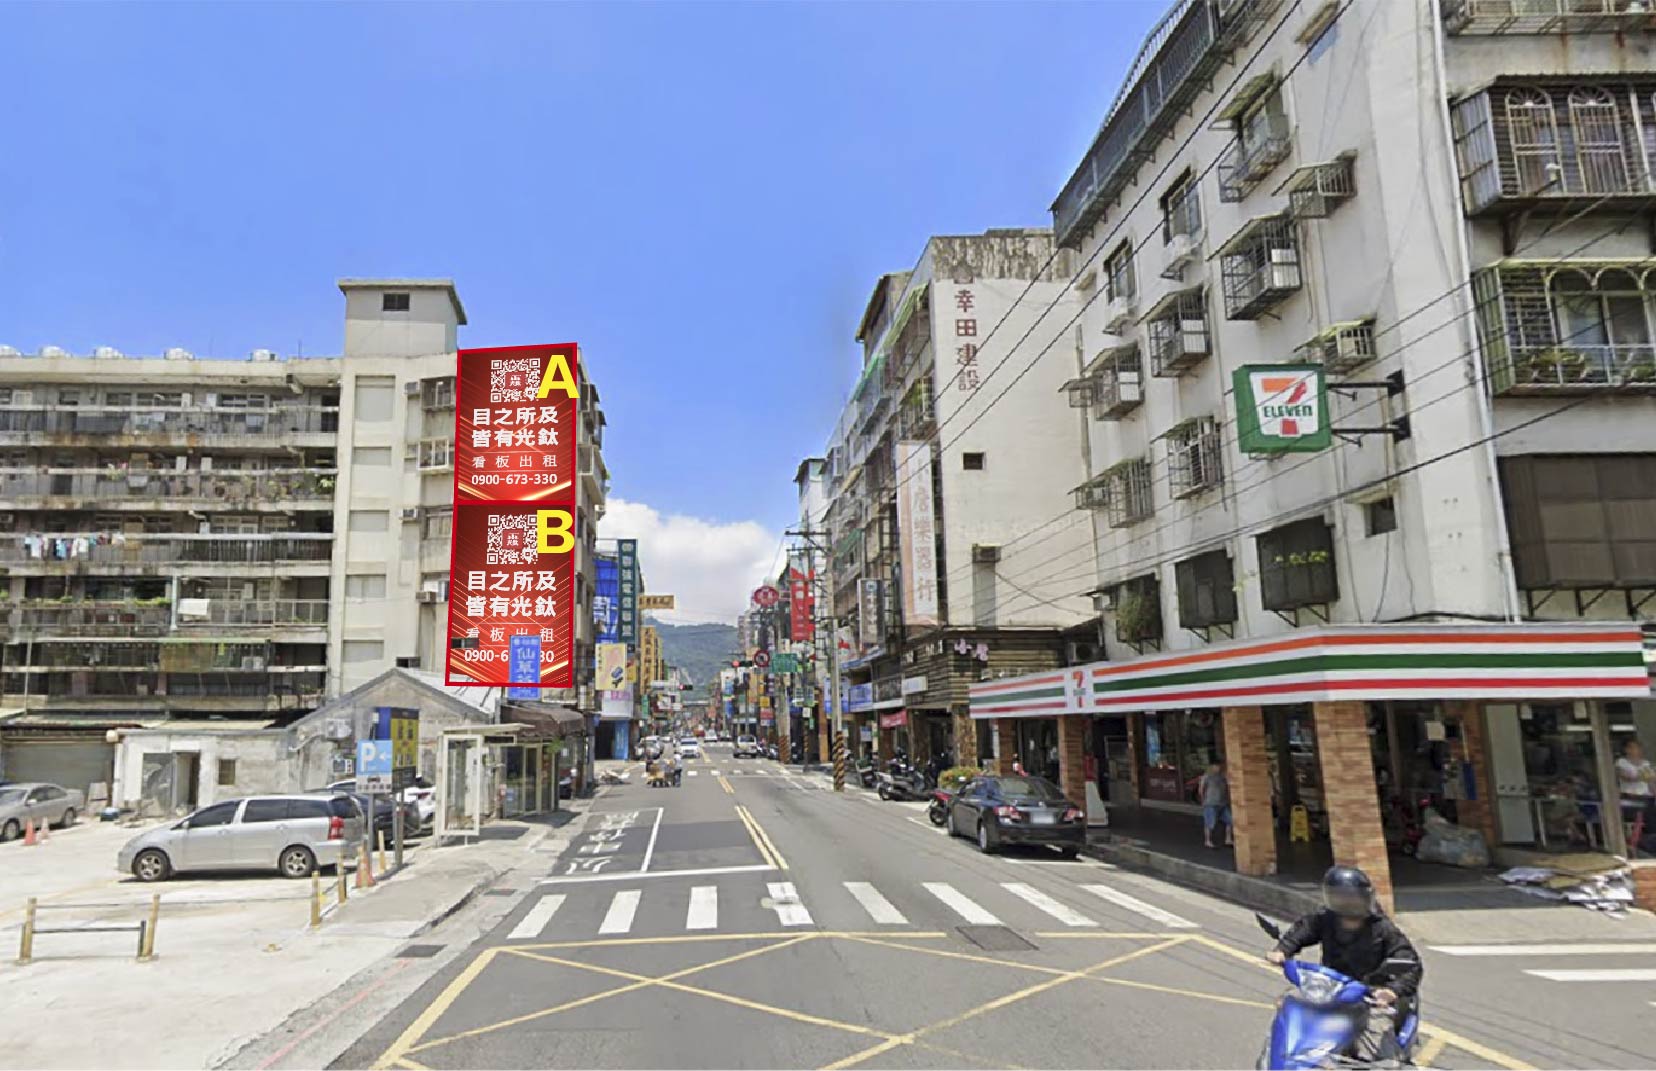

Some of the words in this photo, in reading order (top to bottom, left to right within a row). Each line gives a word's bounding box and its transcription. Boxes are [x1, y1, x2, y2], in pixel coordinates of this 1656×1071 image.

[954, 289, 980, 391] 幸田建設
[472, 406, 559, 426] 目之所及
[471, 427, 559, 448] 皆有光鈦
[471, 454, 558, 469] 看板出租
[471, 473, 558, 486] 0900-673-330
[467, 570, 557, 592] 目之所及
[466, 596, 557, 618] 皆有光鈦
[361, 741, 376, 772] P
